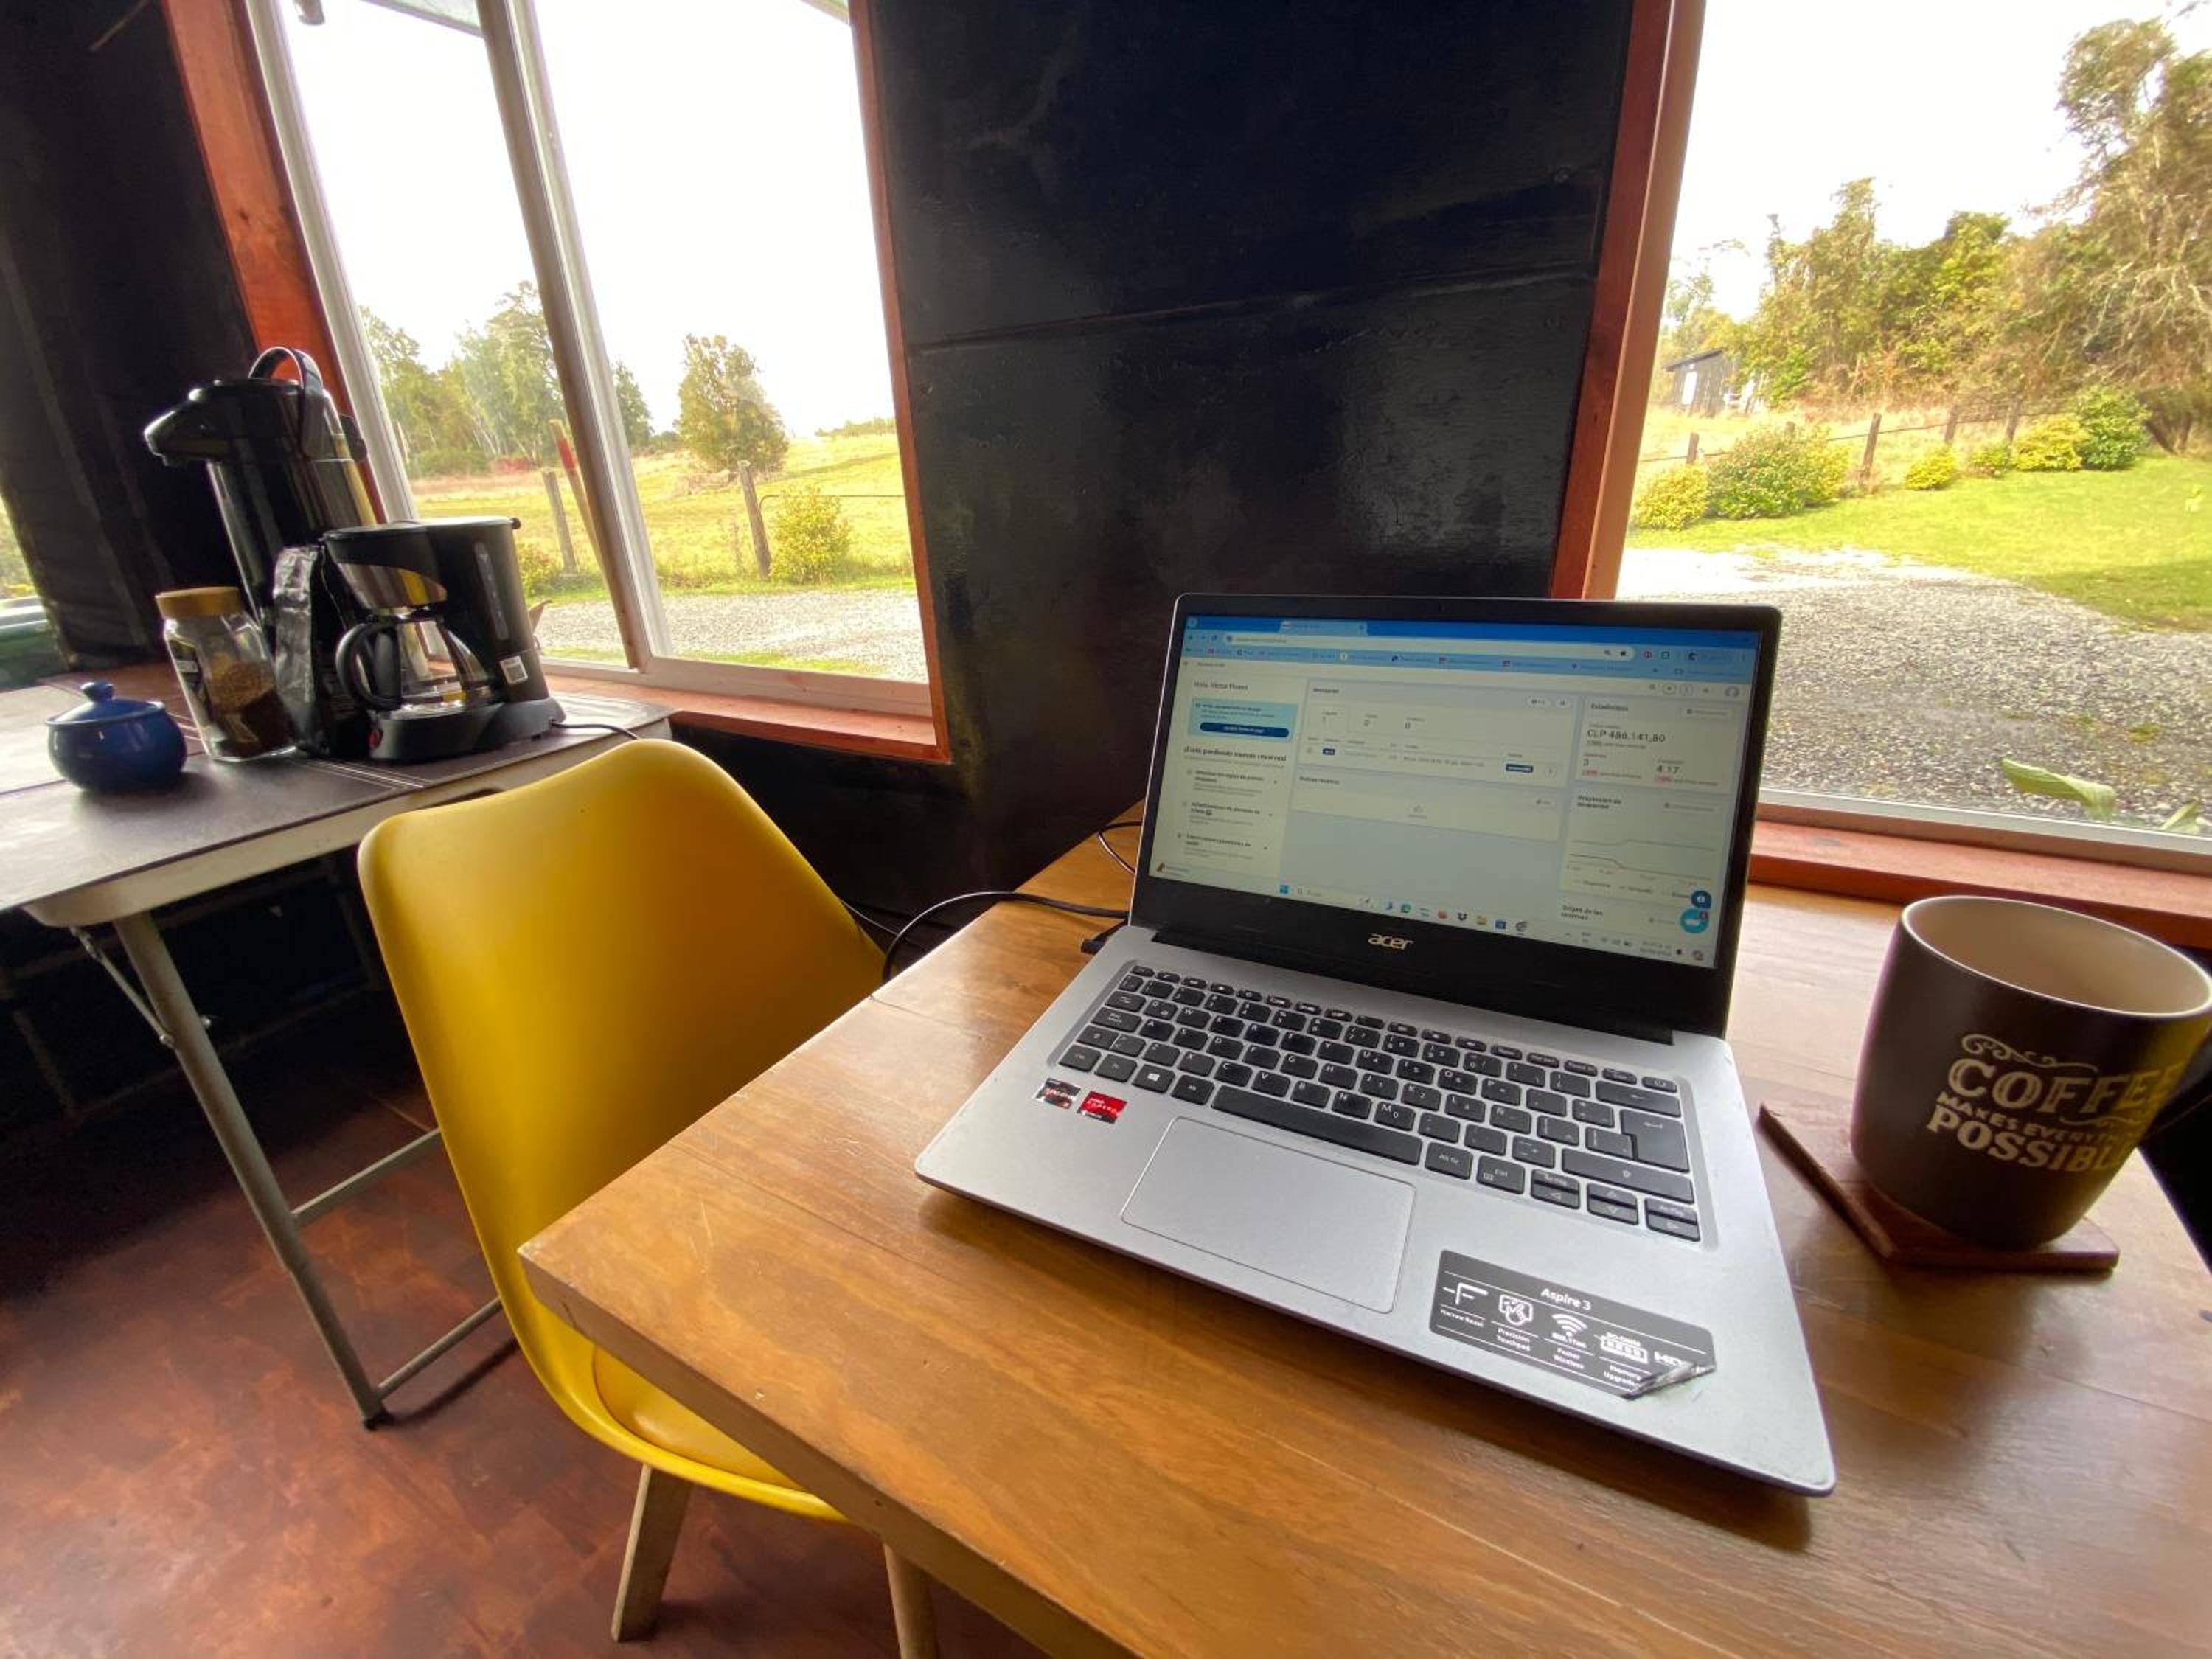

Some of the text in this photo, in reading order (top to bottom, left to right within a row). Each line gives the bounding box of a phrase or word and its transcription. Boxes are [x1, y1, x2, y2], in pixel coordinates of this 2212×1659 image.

[1368, 933, 1414, 951] acer
[1935, 1091, 2019, 1130] MAKES
[1927, 1105, 2124, 1172] POSSIBL
[1540, 1287, 1591, 1311] Aspire 3
